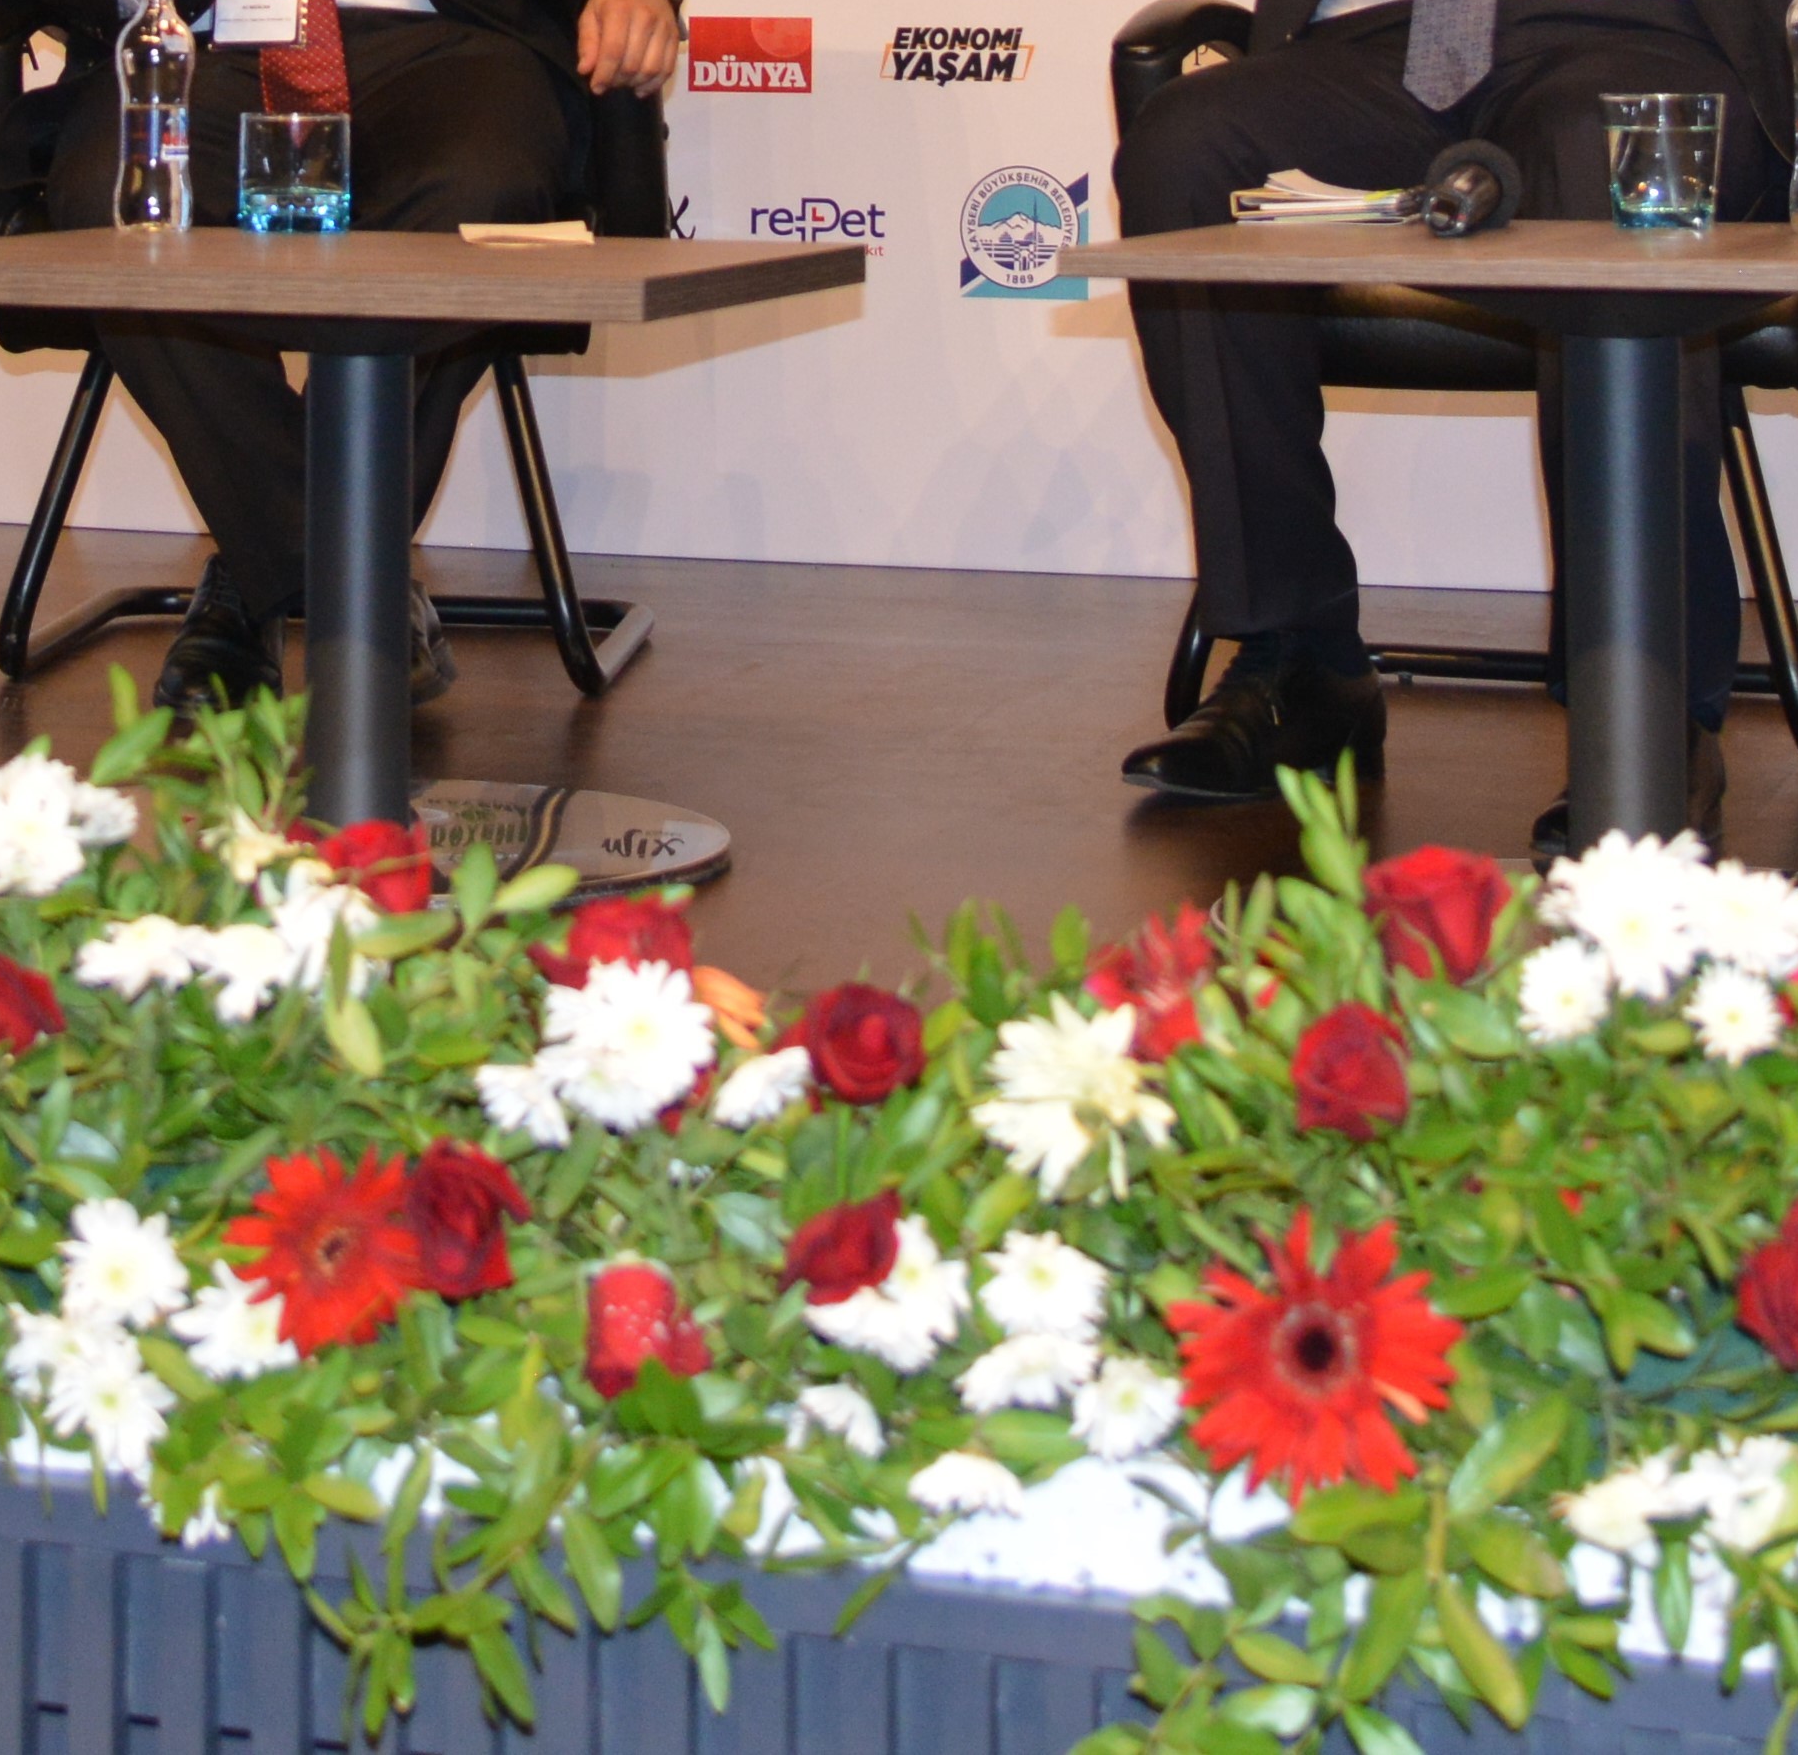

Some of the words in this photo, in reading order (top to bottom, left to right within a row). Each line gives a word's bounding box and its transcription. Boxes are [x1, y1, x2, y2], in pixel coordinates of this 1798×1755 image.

[693, 56, 806, 88] DÜNYA
[892, 51, 1017, 88] YAŞAM
[1051, 188, 1075, 248] BELEDİYES
[1006, 274, 1034, 284] 1869
